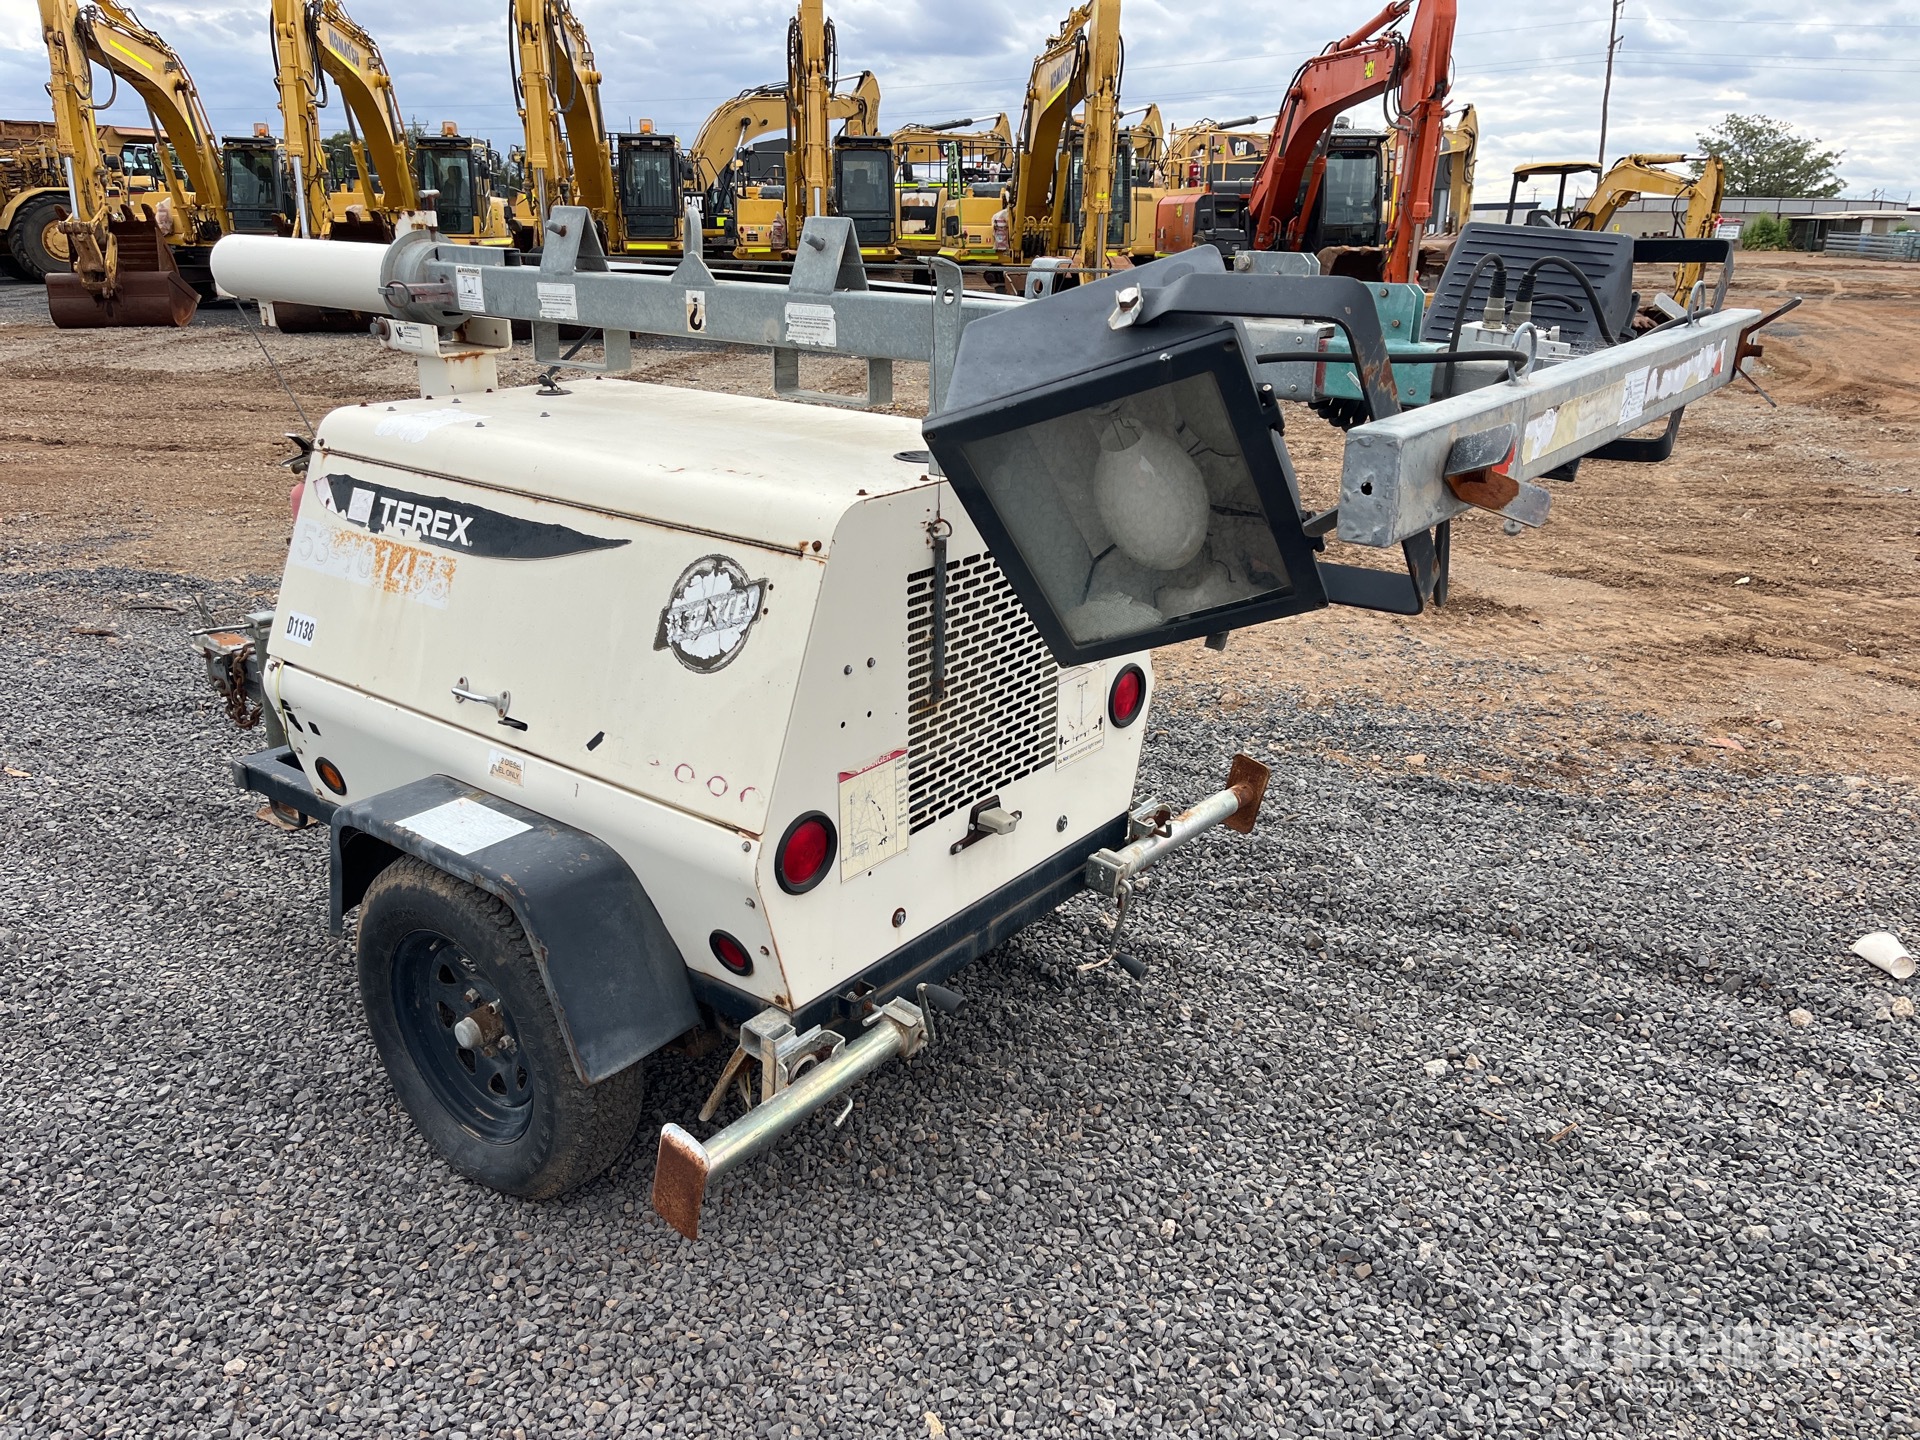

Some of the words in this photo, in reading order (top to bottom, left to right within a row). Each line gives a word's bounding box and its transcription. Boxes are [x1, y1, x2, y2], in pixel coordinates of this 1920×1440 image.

[328, 28, 360, 68] KOMATSU
[1234, 140, 1248, 156] CAT
[683, 195, 703, 211] CAT
[461, 267, 480, 275] WARNING
[380, 497, 473, 547] TEREX
[286, 615, 315, 642] D1138
[505, 769, 520, 780] ONLY
